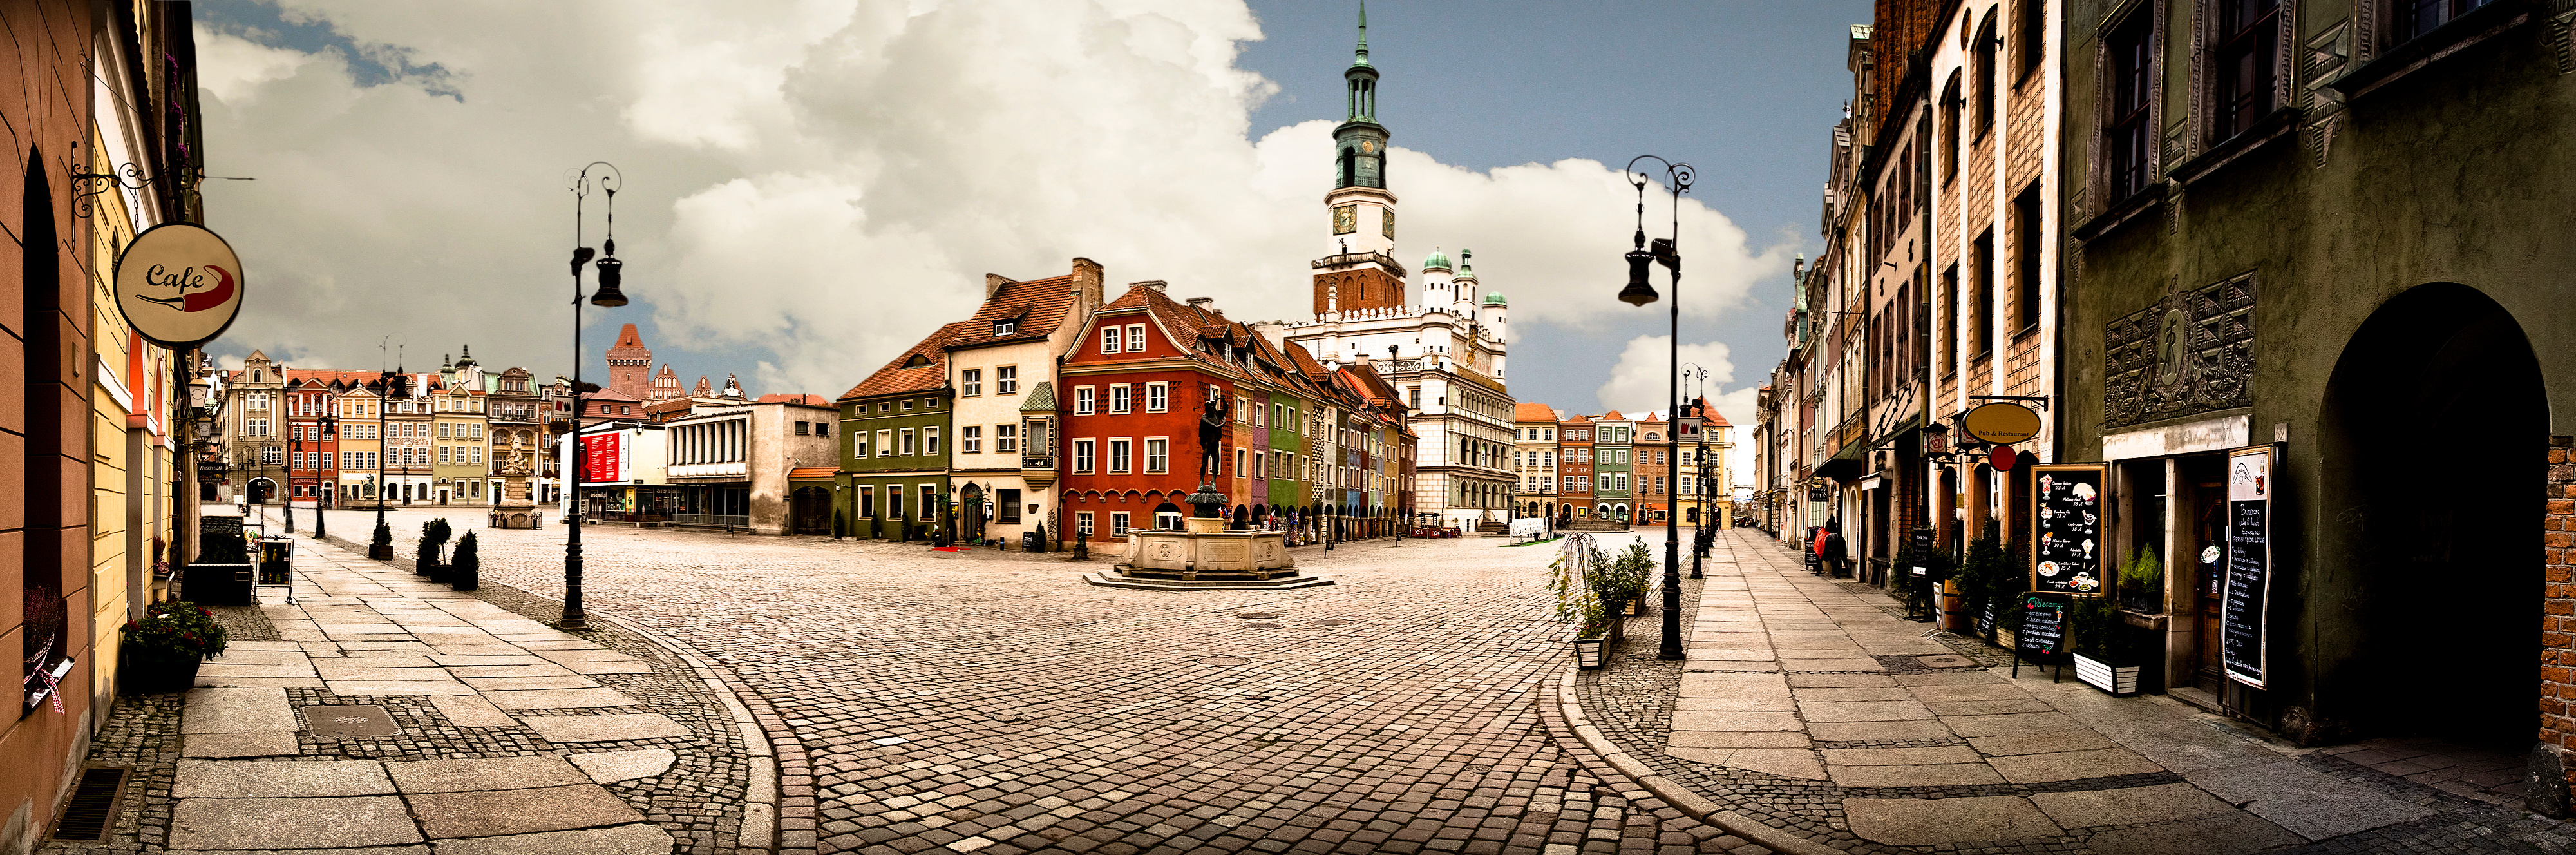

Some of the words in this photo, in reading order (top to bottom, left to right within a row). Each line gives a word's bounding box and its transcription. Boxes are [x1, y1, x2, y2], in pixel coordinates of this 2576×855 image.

[146, 264, 204, 294] Cafe
[2276, 427, 2284, 441] 52
[2034, 597, 2063, 611] Polecamy:
